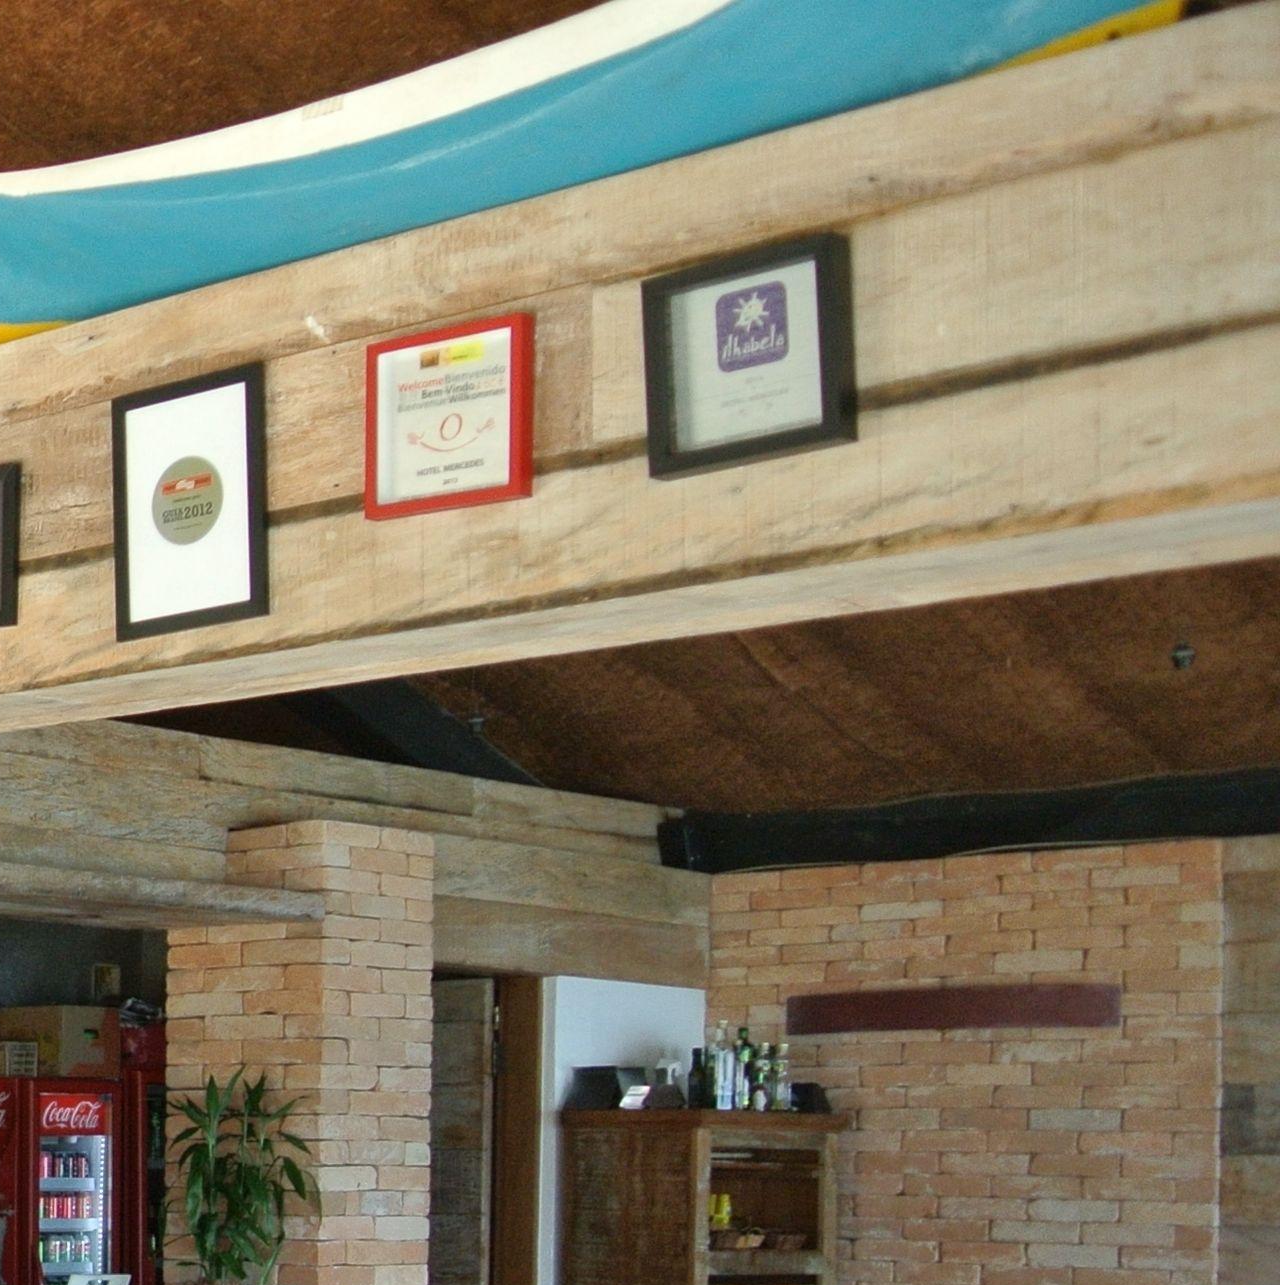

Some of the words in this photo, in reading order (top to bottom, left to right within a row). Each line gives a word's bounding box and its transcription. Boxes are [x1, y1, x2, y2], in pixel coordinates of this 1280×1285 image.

[398, 378, 444, 392] Welcome
[445, 364, 506, 383] Bienvenido
[417, 466, 441, 476] HOTEL
[443, 458, 484, 472] MERCEDES
[184, 501, 214, 520] 2012
[43, 1101, 102, 1128] Coca-Cola
